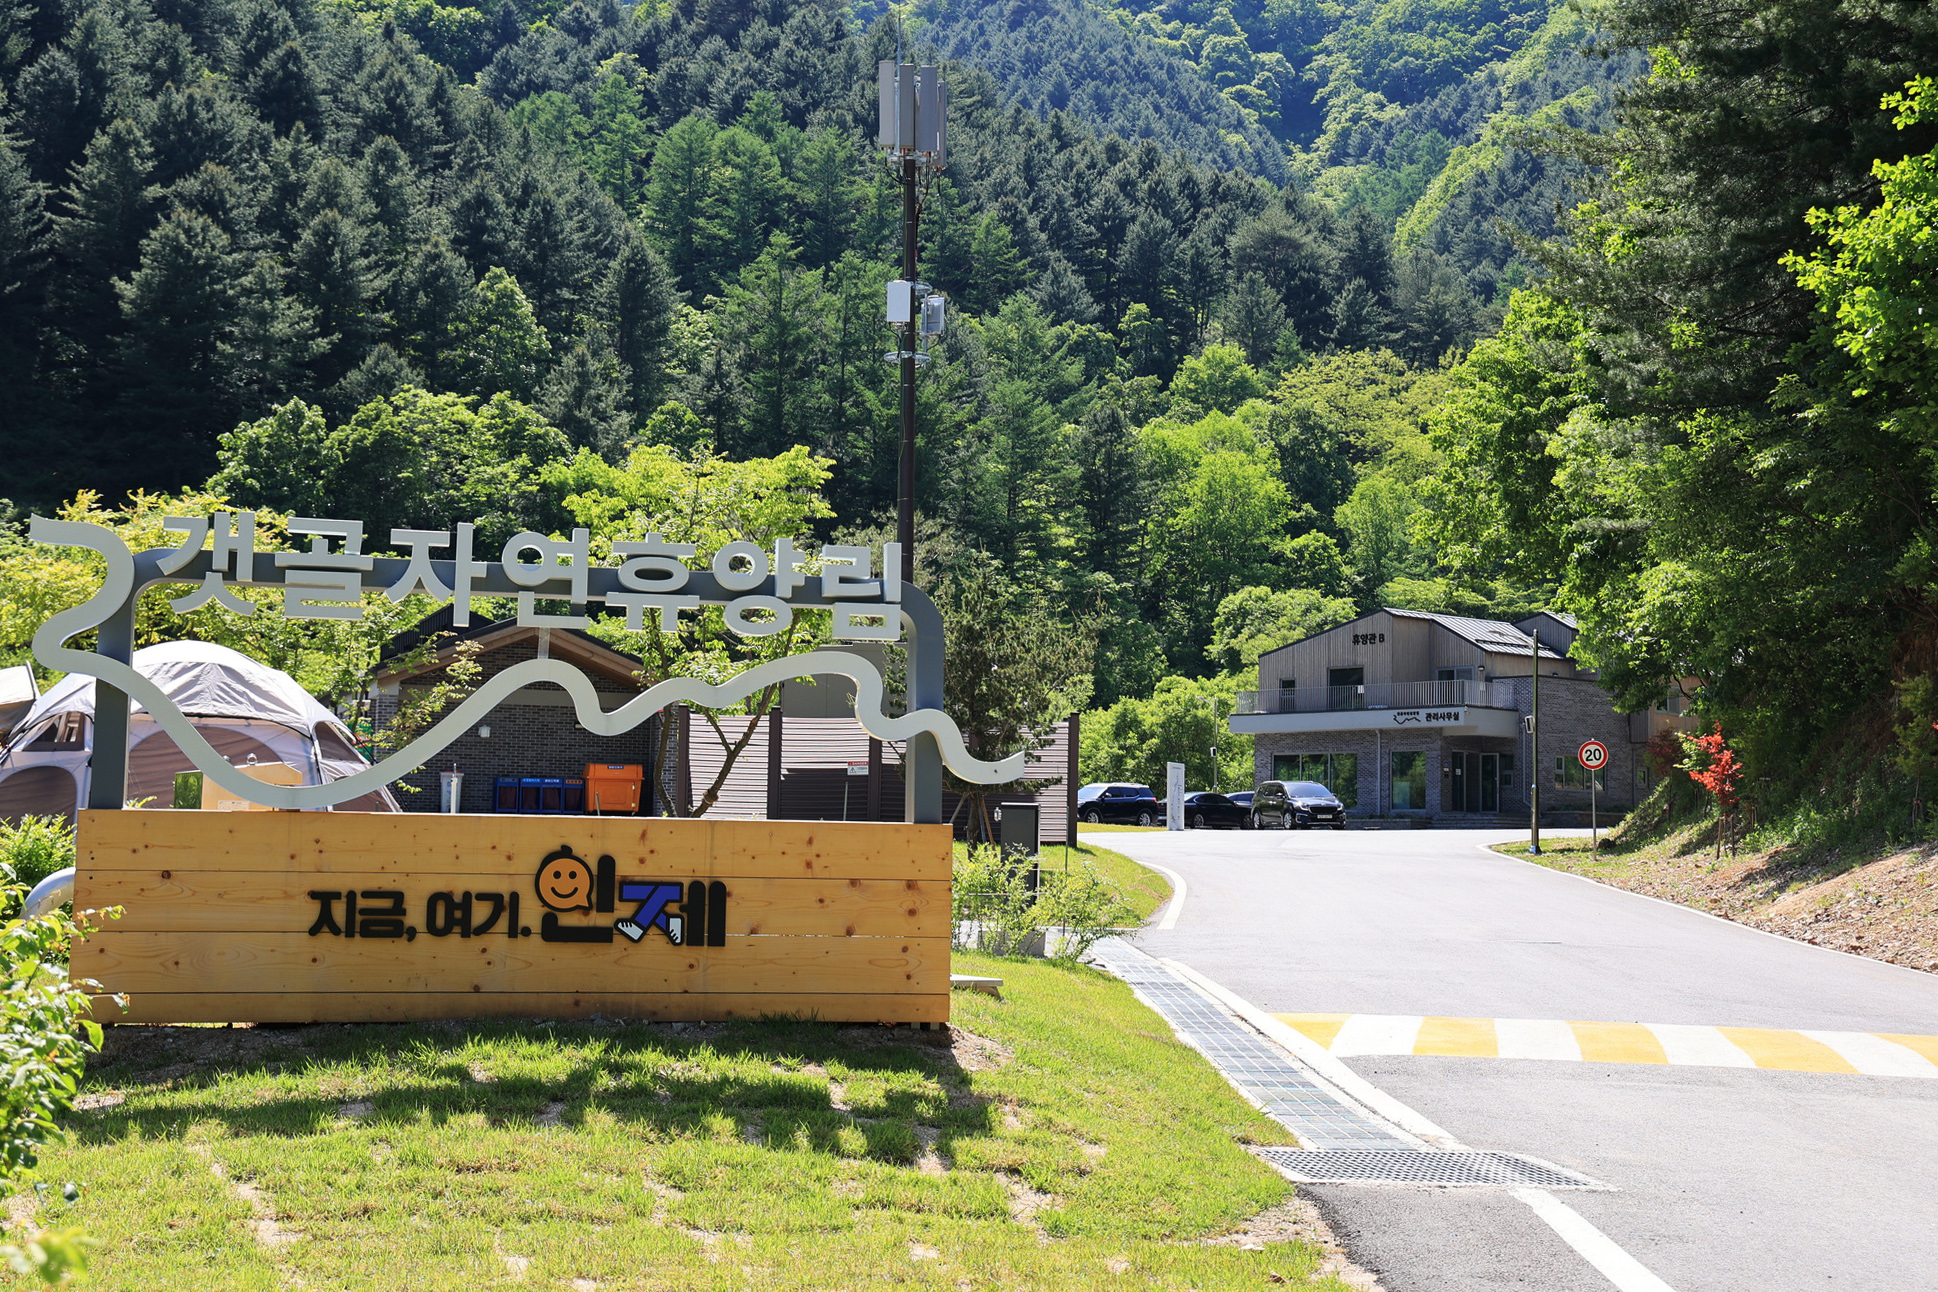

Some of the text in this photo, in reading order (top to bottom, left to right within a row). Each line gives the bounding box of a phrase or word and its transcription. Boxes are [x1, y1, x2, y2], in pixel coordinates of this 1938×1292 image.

[156, 511, 902, 641] 갯골자연휴양림
[1352, 633, 1385, 646] 휴양관 B
[1425, 711, 1460, 722] 관리사무실
[1585, 748, 1602, 762] 20
[308, 844, 728, 948] 지금, 여기. 인제
